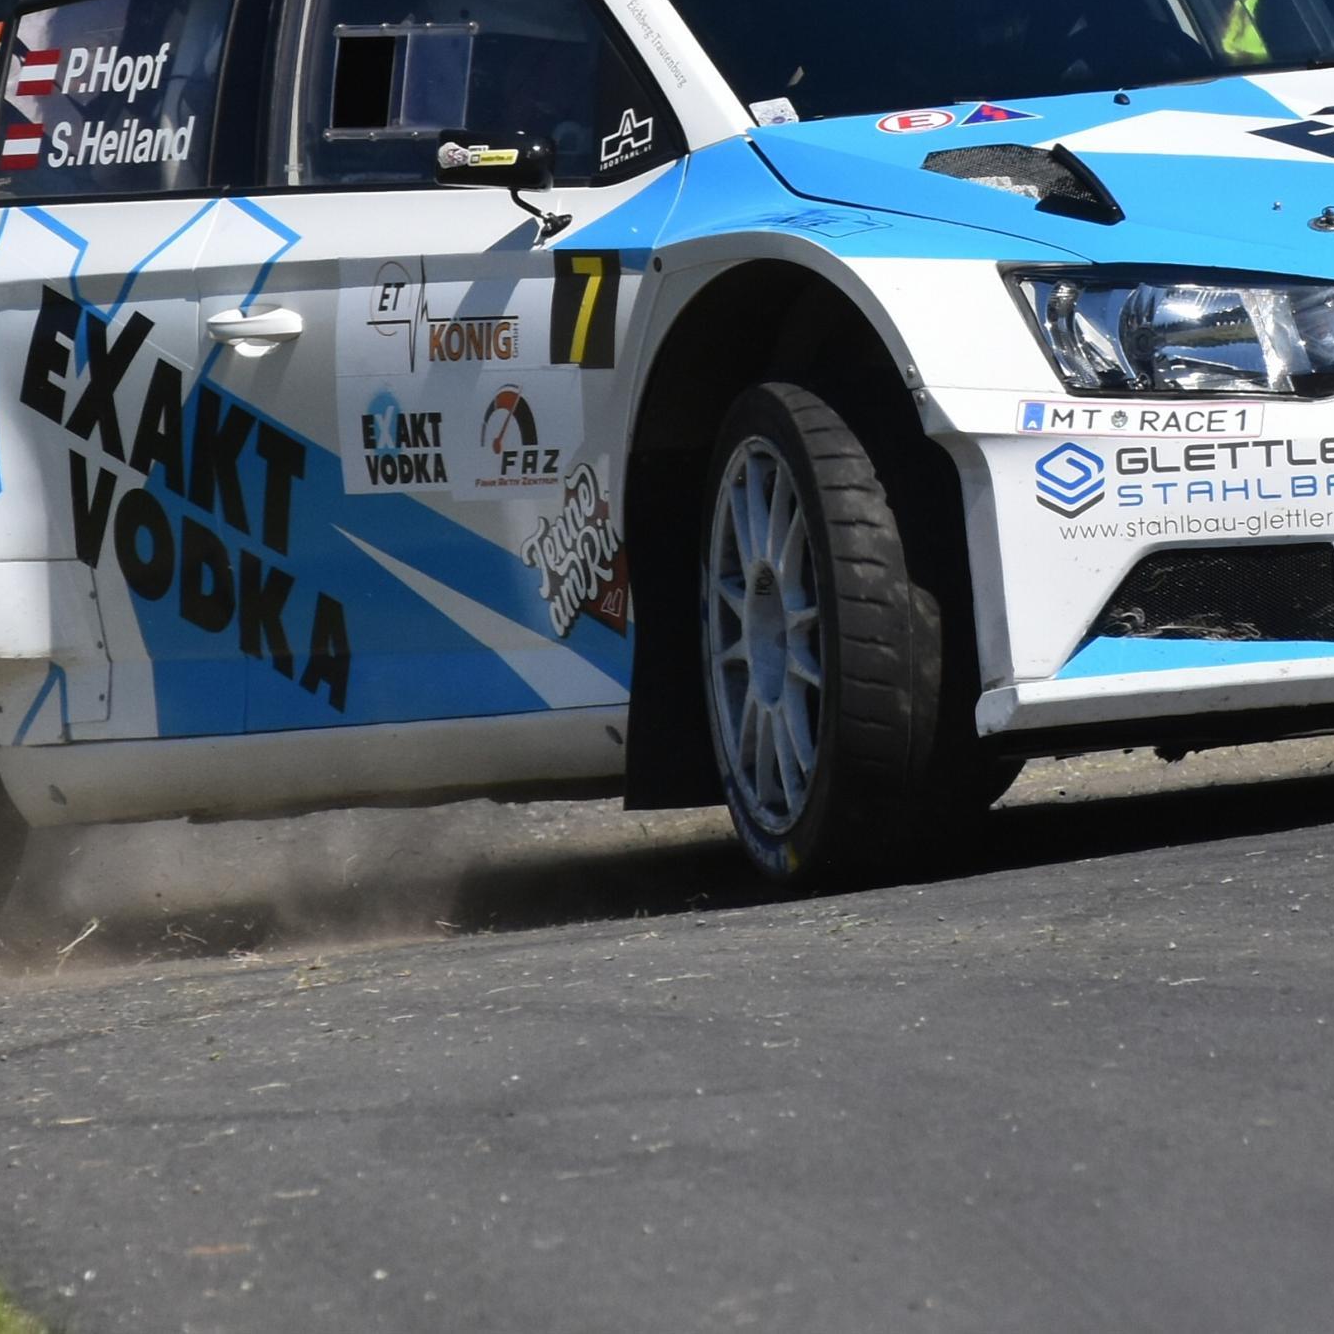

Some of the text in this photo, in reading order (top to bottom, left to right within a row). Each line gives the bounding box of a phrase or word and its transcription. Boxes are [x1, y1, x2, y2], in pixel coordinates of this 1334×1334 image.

[61, 42, 171, 104] P.Hopf
[47, 115, 196, 169] S.Heiland
[378, 282, 406, 312] ET
[570, 256, 603, 364] 7
[428, 317, 512, 362] KÖNIG
[20, 284, 307, 557] EXAKT
[361, 405, 443, 450] EXAKT
[365, 453, 449, 486] VODKA
[501, 449, 560, 476] FAZ
[521, 463, 596, 600] Tenne
[69, 448, 352, 715] VODKA
